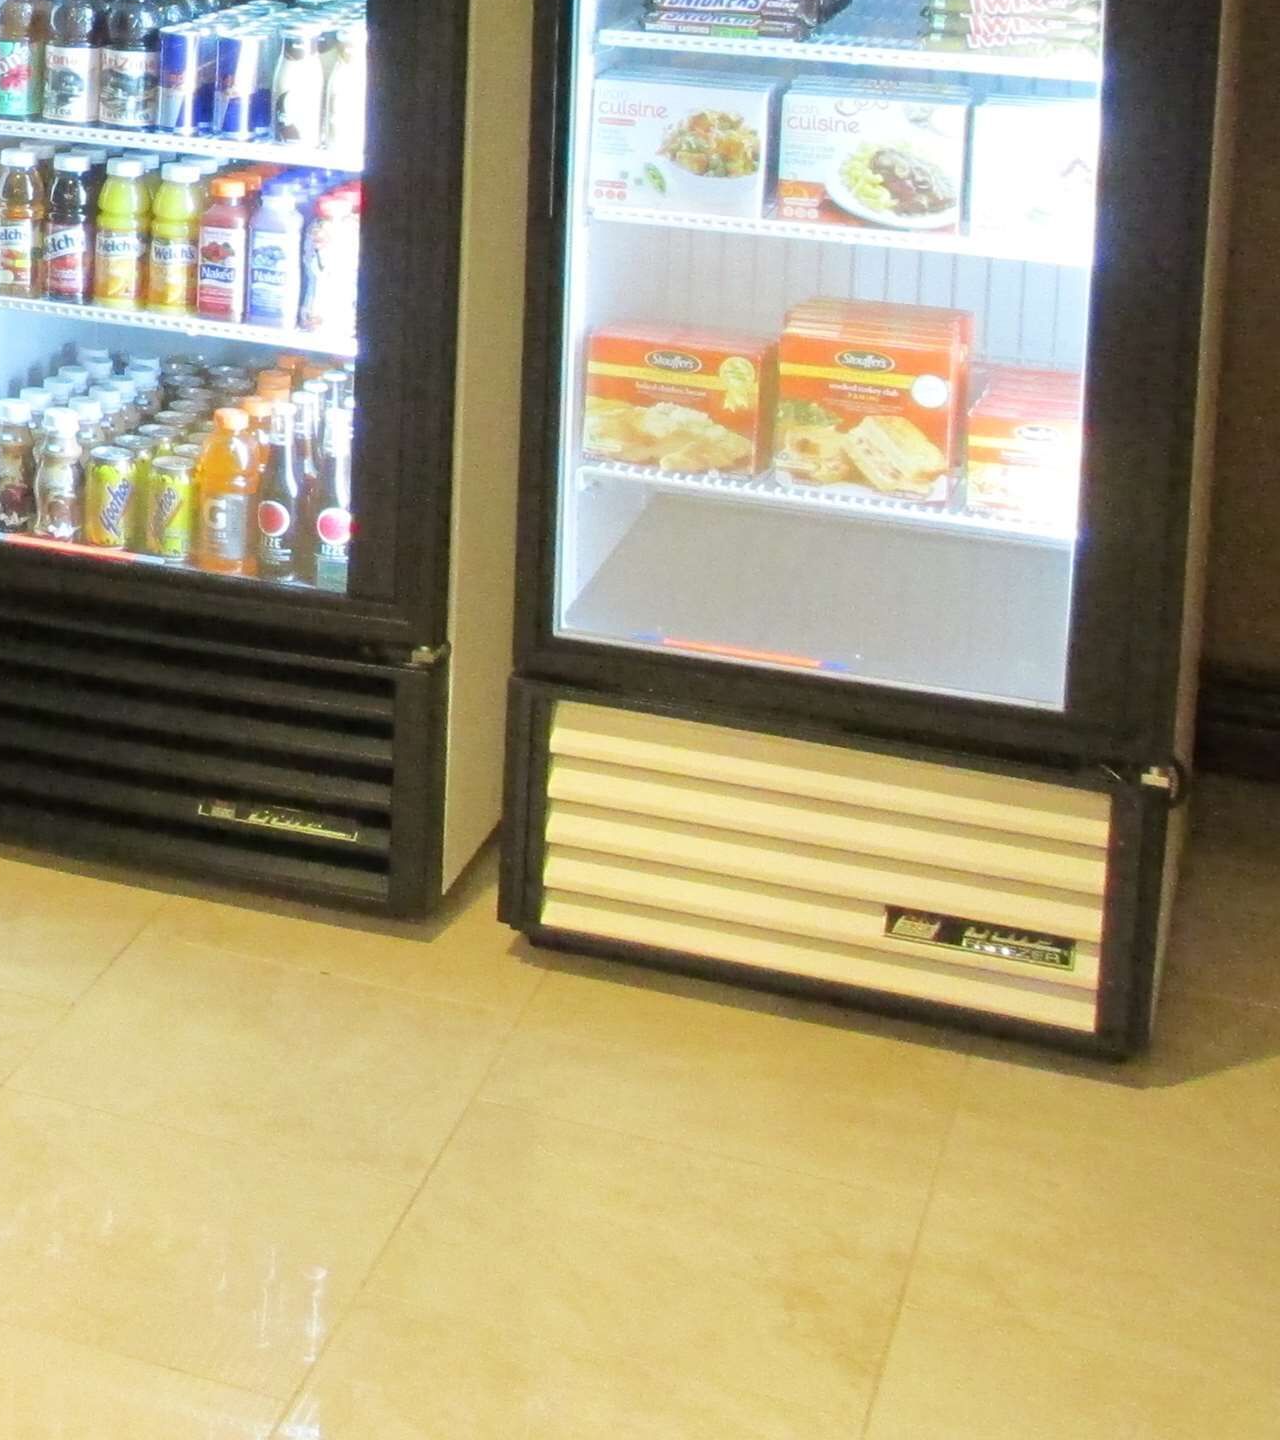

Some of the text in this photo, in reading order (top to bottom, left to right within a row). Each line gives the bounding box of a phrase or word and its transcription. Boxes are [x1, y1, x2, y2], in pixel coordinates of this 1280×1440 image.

[597, 99, 670, 120] cuisine
[786, 114, 860, 135] cuisine
[201, 265, 235, 282] Naked
[320, 543, 347, 556] IZZE
[961, 937, 1061, 964] FEZER
